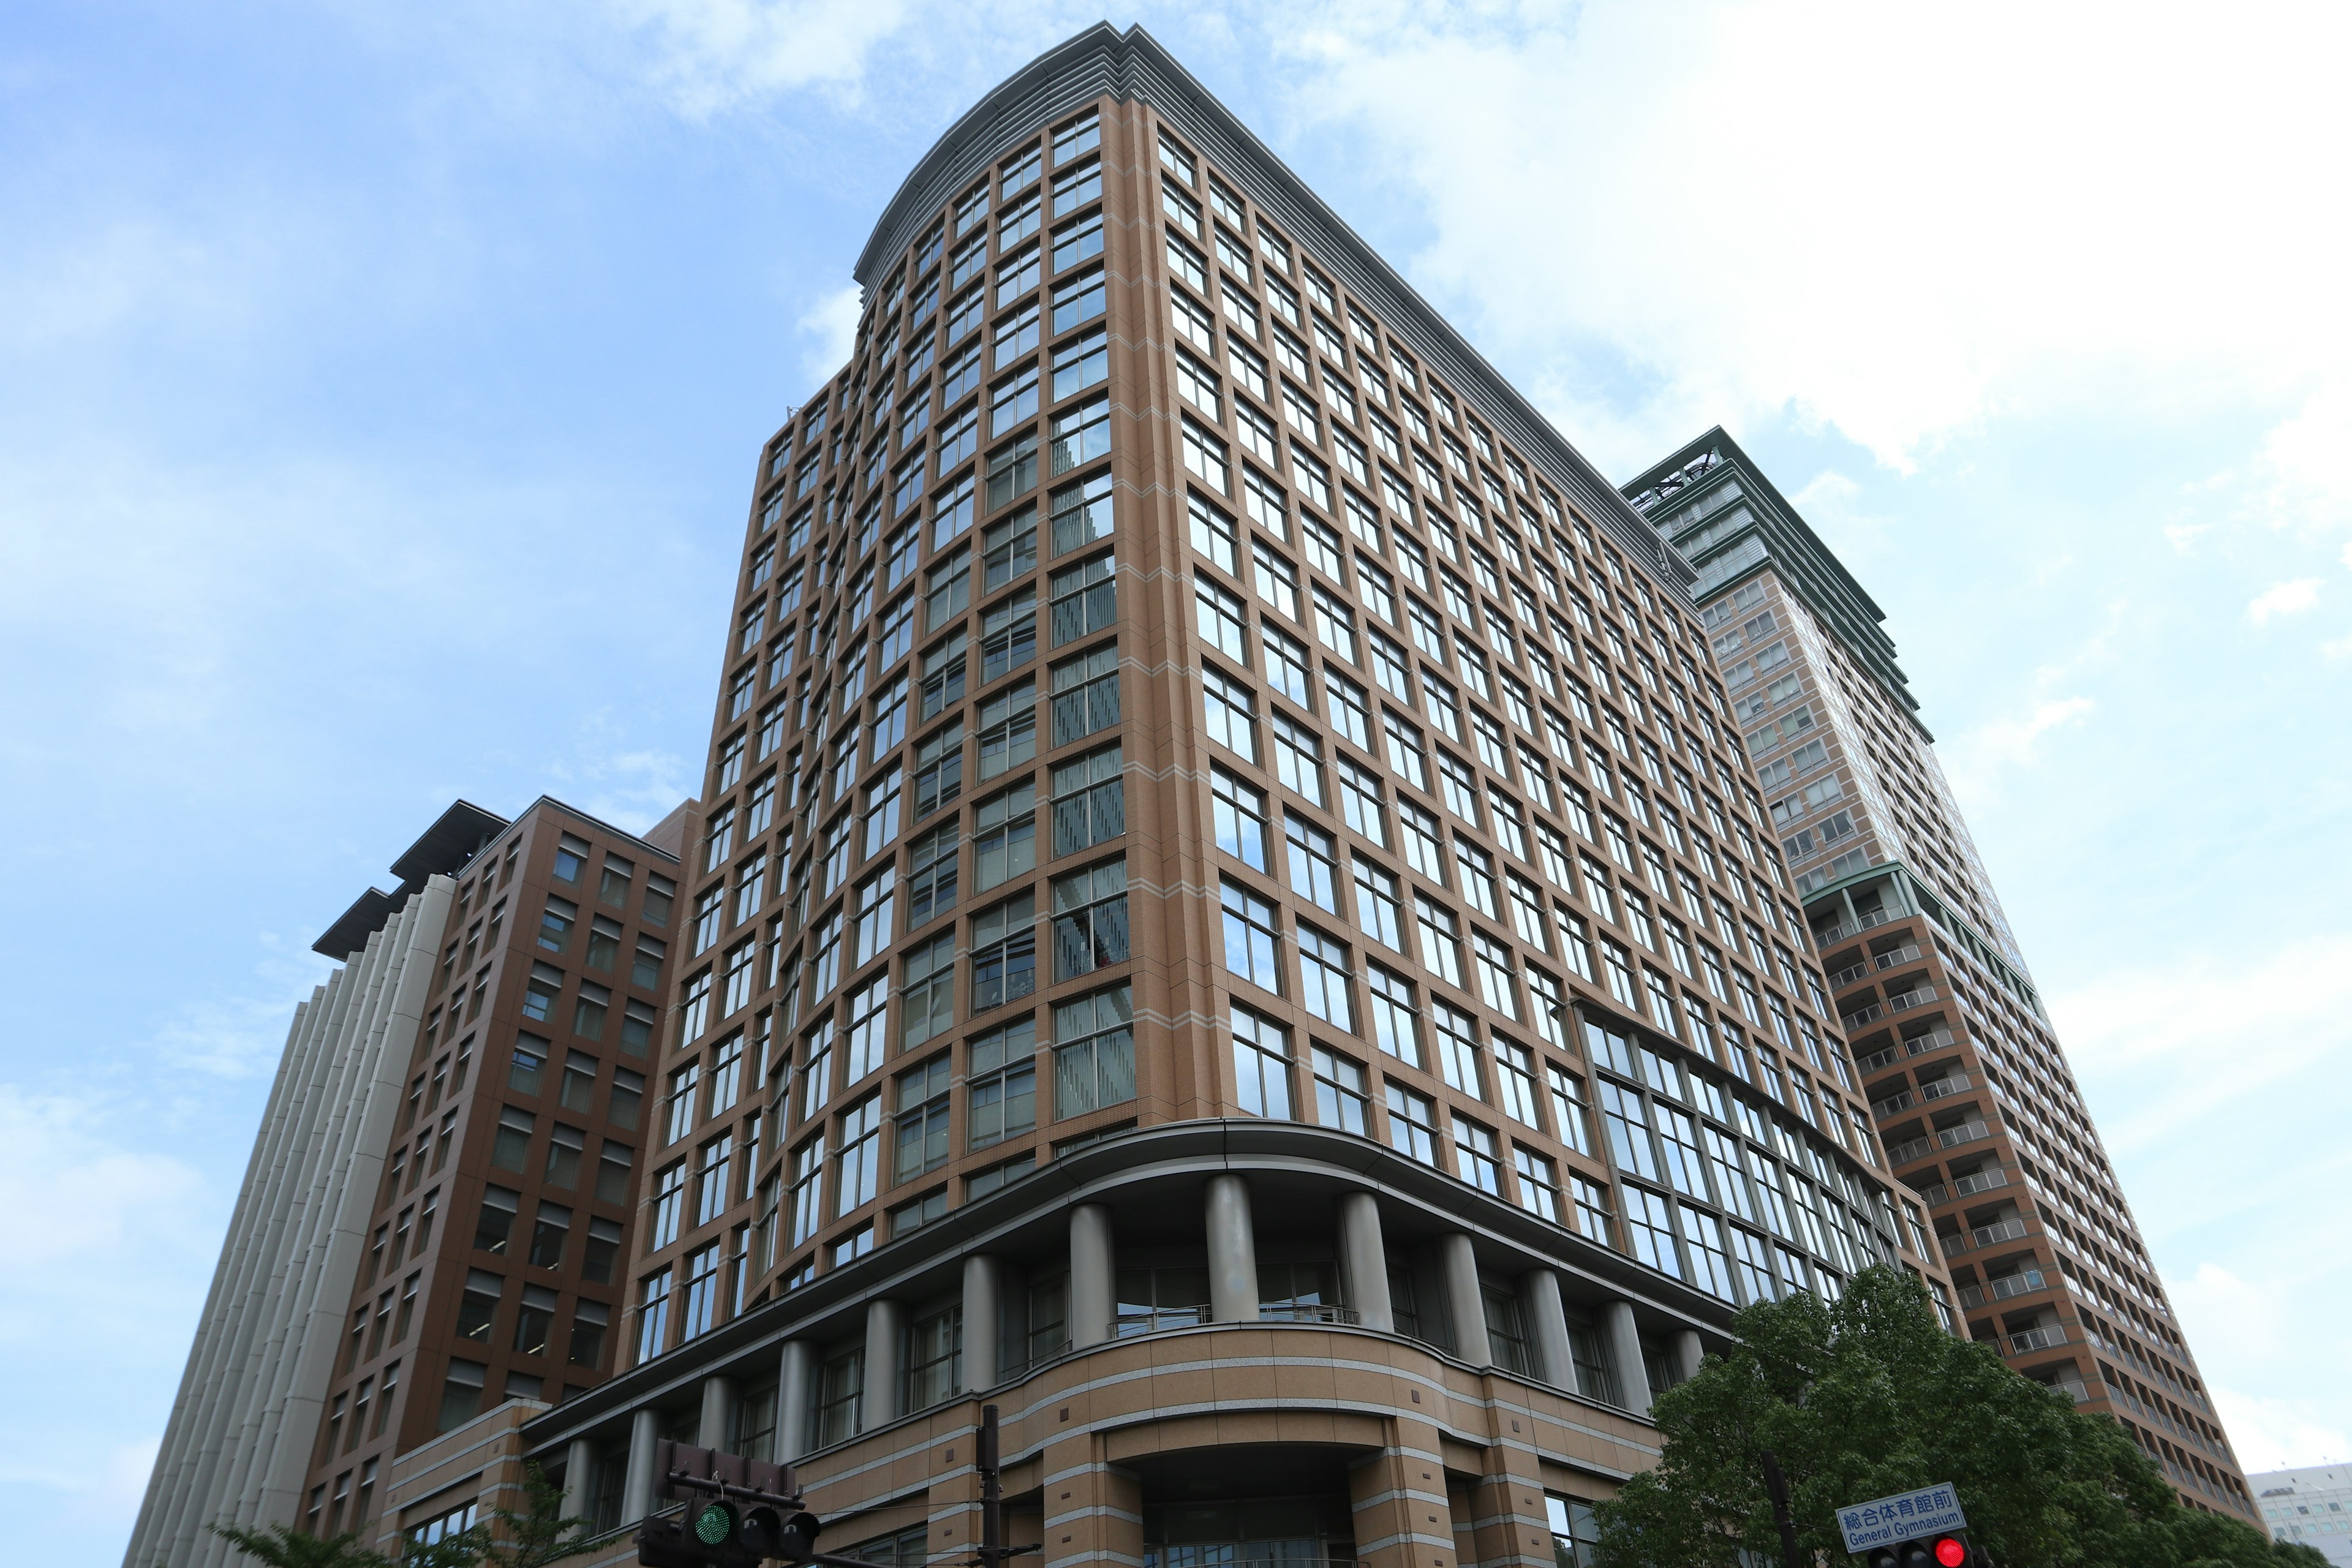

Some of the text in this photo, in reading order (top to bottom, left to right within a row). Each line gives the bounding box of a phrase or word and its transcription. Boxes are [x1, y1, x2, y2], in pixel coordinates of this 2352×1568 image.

[1844, 1490, 1953, 1531] 総合体育館前
[1849, 1513, 1959, 1545] General Gymnasium
